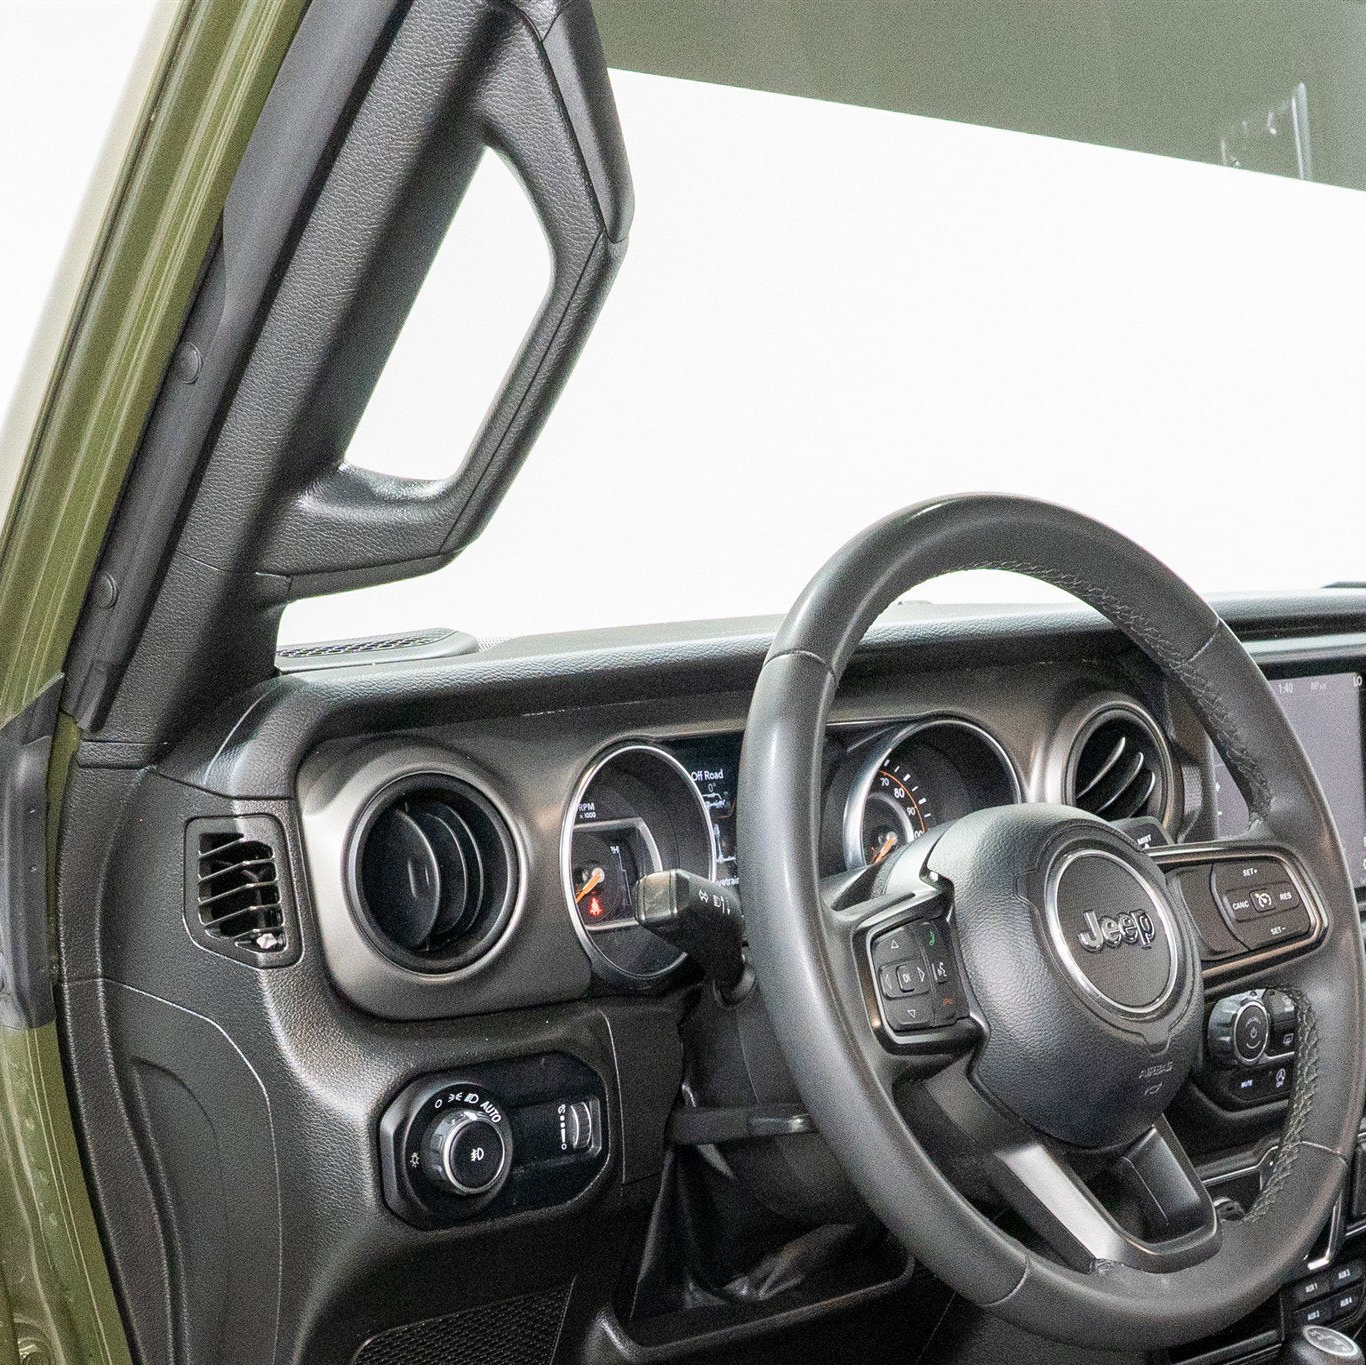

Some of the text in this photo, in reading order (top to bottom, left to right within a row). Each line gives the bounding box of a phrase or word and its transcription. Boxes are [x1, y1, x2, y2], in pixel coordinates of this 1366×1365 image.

[704, 769, 724, 780] Road
[880, 778, 890, 787] 70
[893, 787, 905, 799] 80
[578, 802, 595, 811] RPM
[906, 806, 916, 816] 90
[1279, 891, 1292, 901] RES
[1232, 900, 1250, 911] CANC
[1078, 908, 1156, 954] Jeep
[480, 1101, 502, 1124] AUTO
